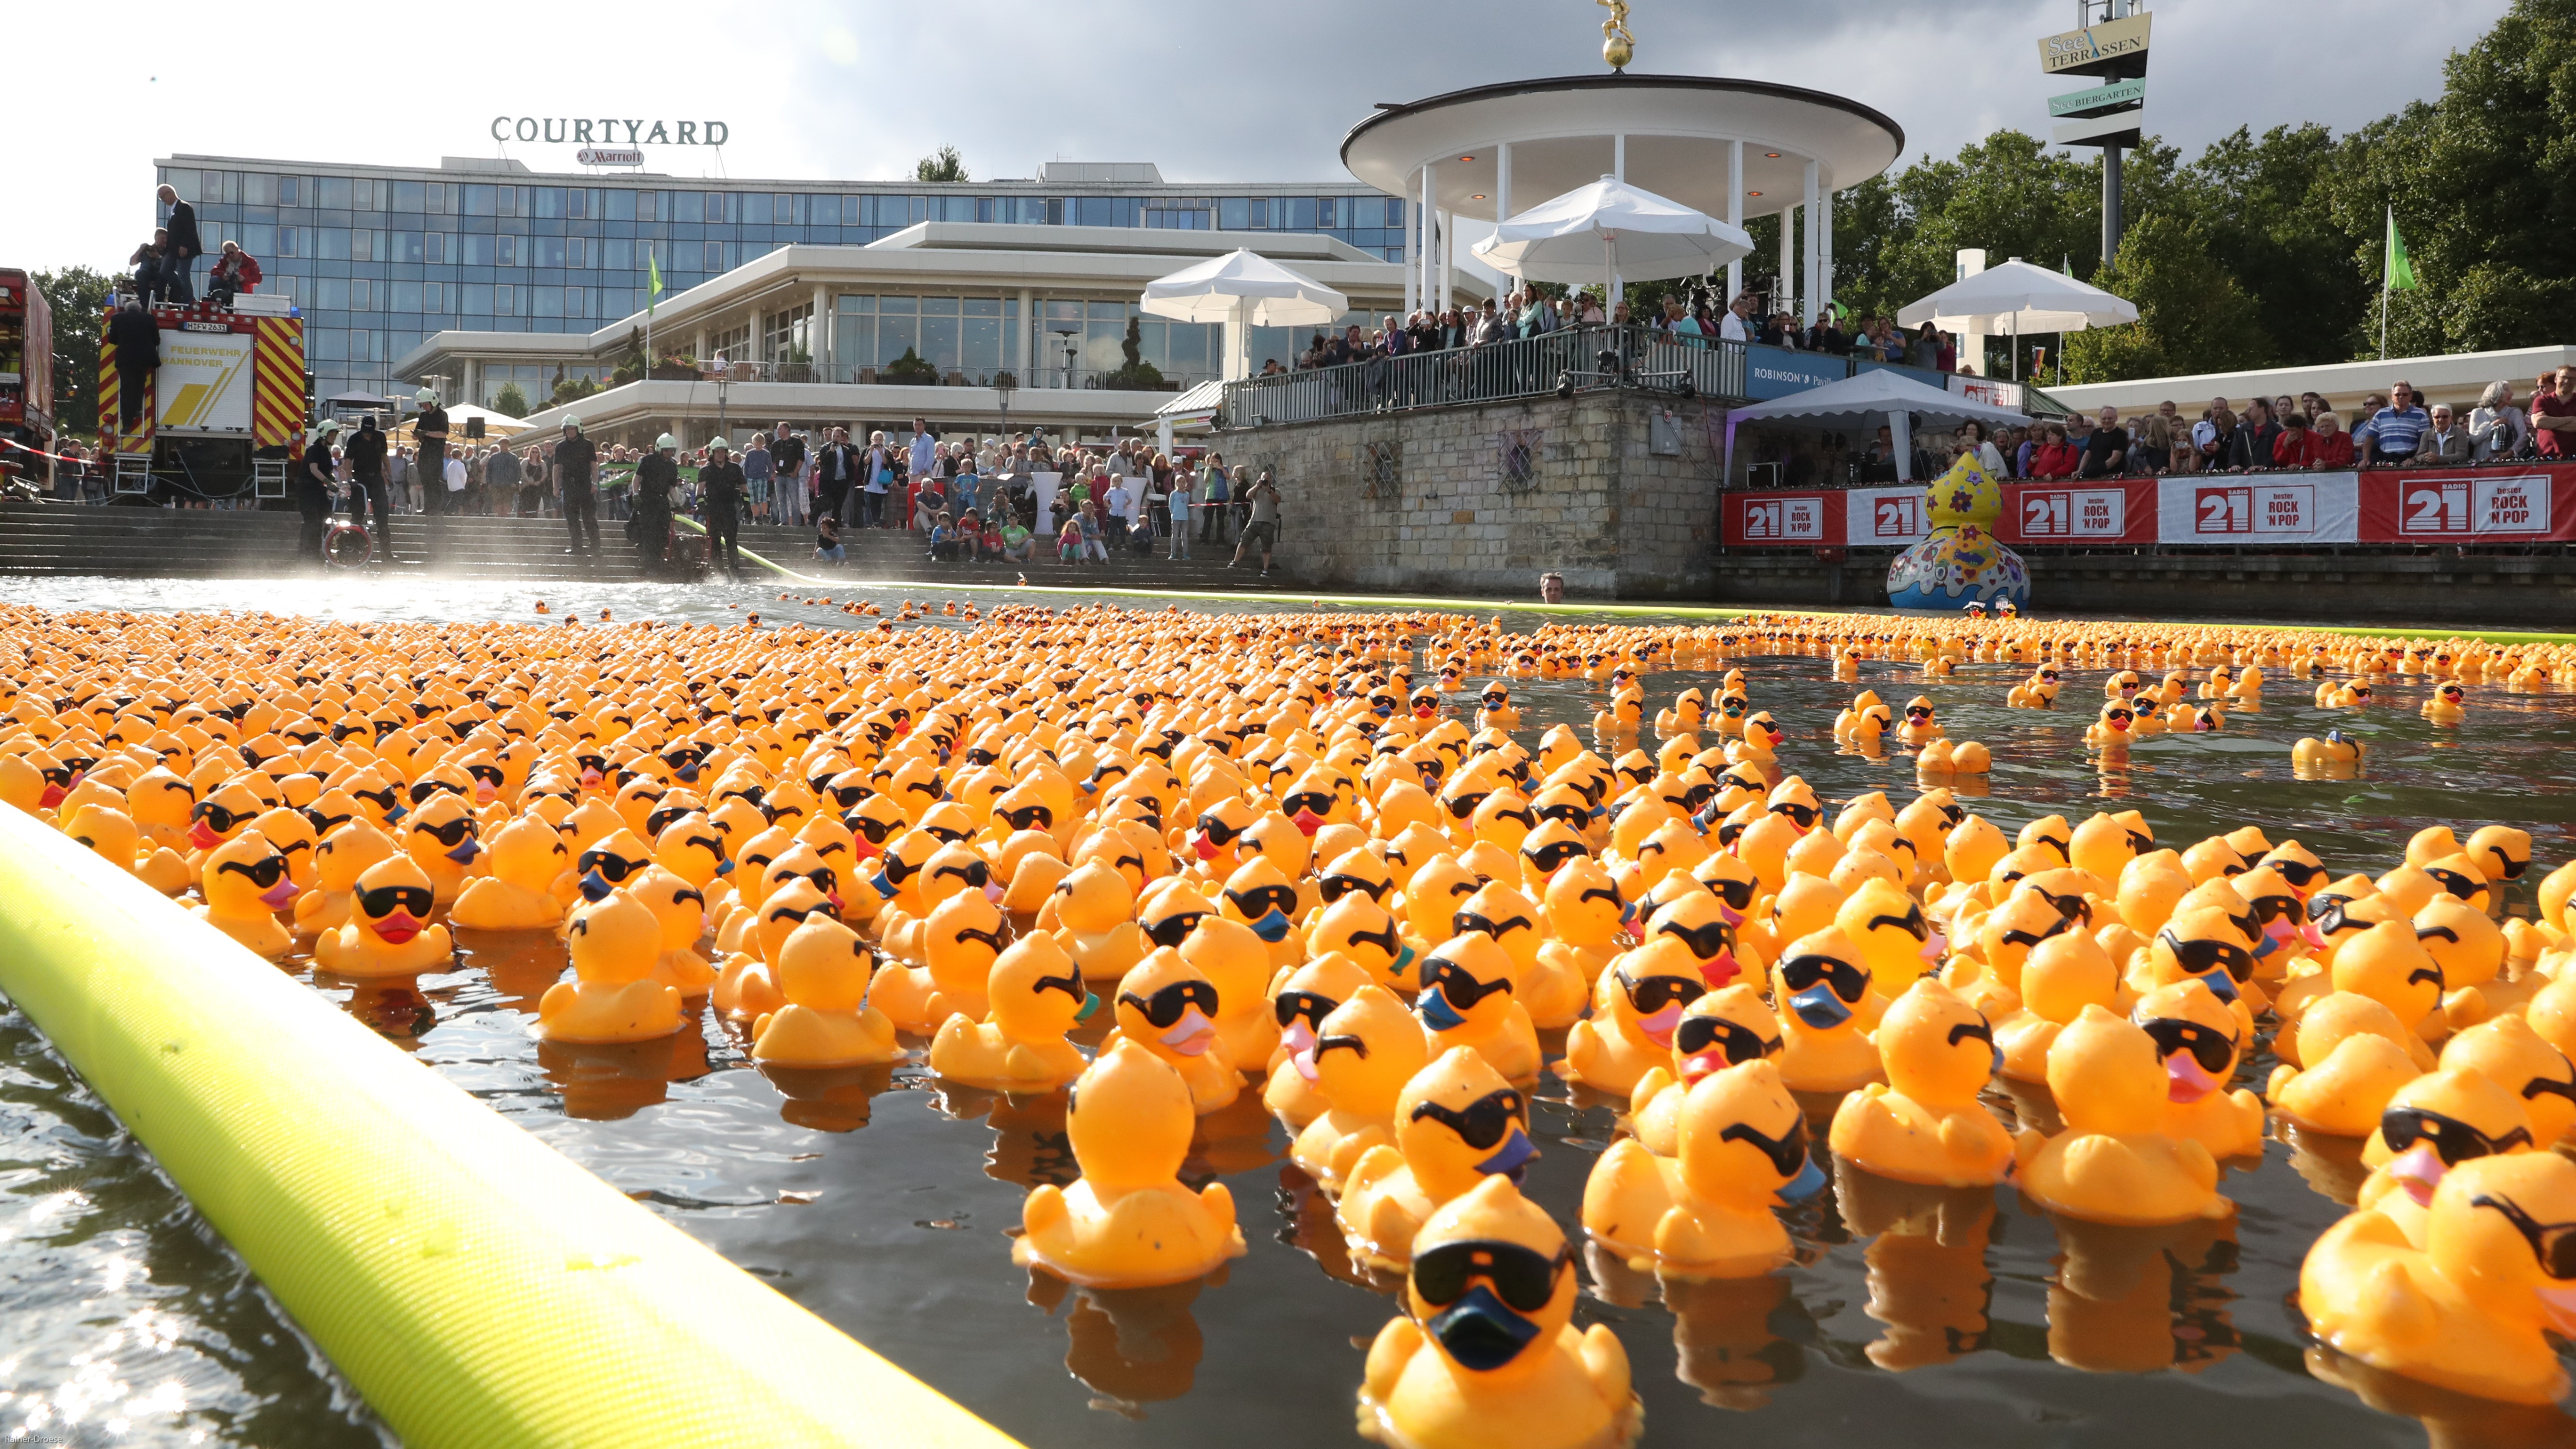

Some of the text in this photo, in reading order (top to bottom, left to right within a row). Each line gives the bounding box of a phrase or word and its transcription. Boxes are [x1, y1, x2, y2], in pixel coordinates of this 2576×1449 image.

[2049, 36, 2085, 56] See
[2049, 36, 2141, 68] TERRASSEN
[491, 116, 728, 145] COURTYARD
[591, 151, 640, 163] Marriott
[170, 346, 241, 356] FEUERWEHR
[161, 356, 223, 367] HANNOVER
[1755, 368, 1800, 383] ROBINSON
[2497, 487, 2522, 495] bester
[2269, 501, 2298, 513] ROCK
[2491, 495, 2528, 509] ROCK
[2025, 499, 2067, 533] 21
[2084, 506, 2109, 516] ROCK
[2199, 495, 2248, 531] 21
[2407, 490, 2467, 530] 21
[2503, 510, 2529, 523] POP
[1748, 507, 1779, 536] 21
[1792, 512, 1811, 522] ROCK
[1877, 503, 1913, 534] 21
[2092, 518, 2110, 528] POP
[2278, 515, 2300, 526] POP
[1798, 523, 1811, 532] POP
